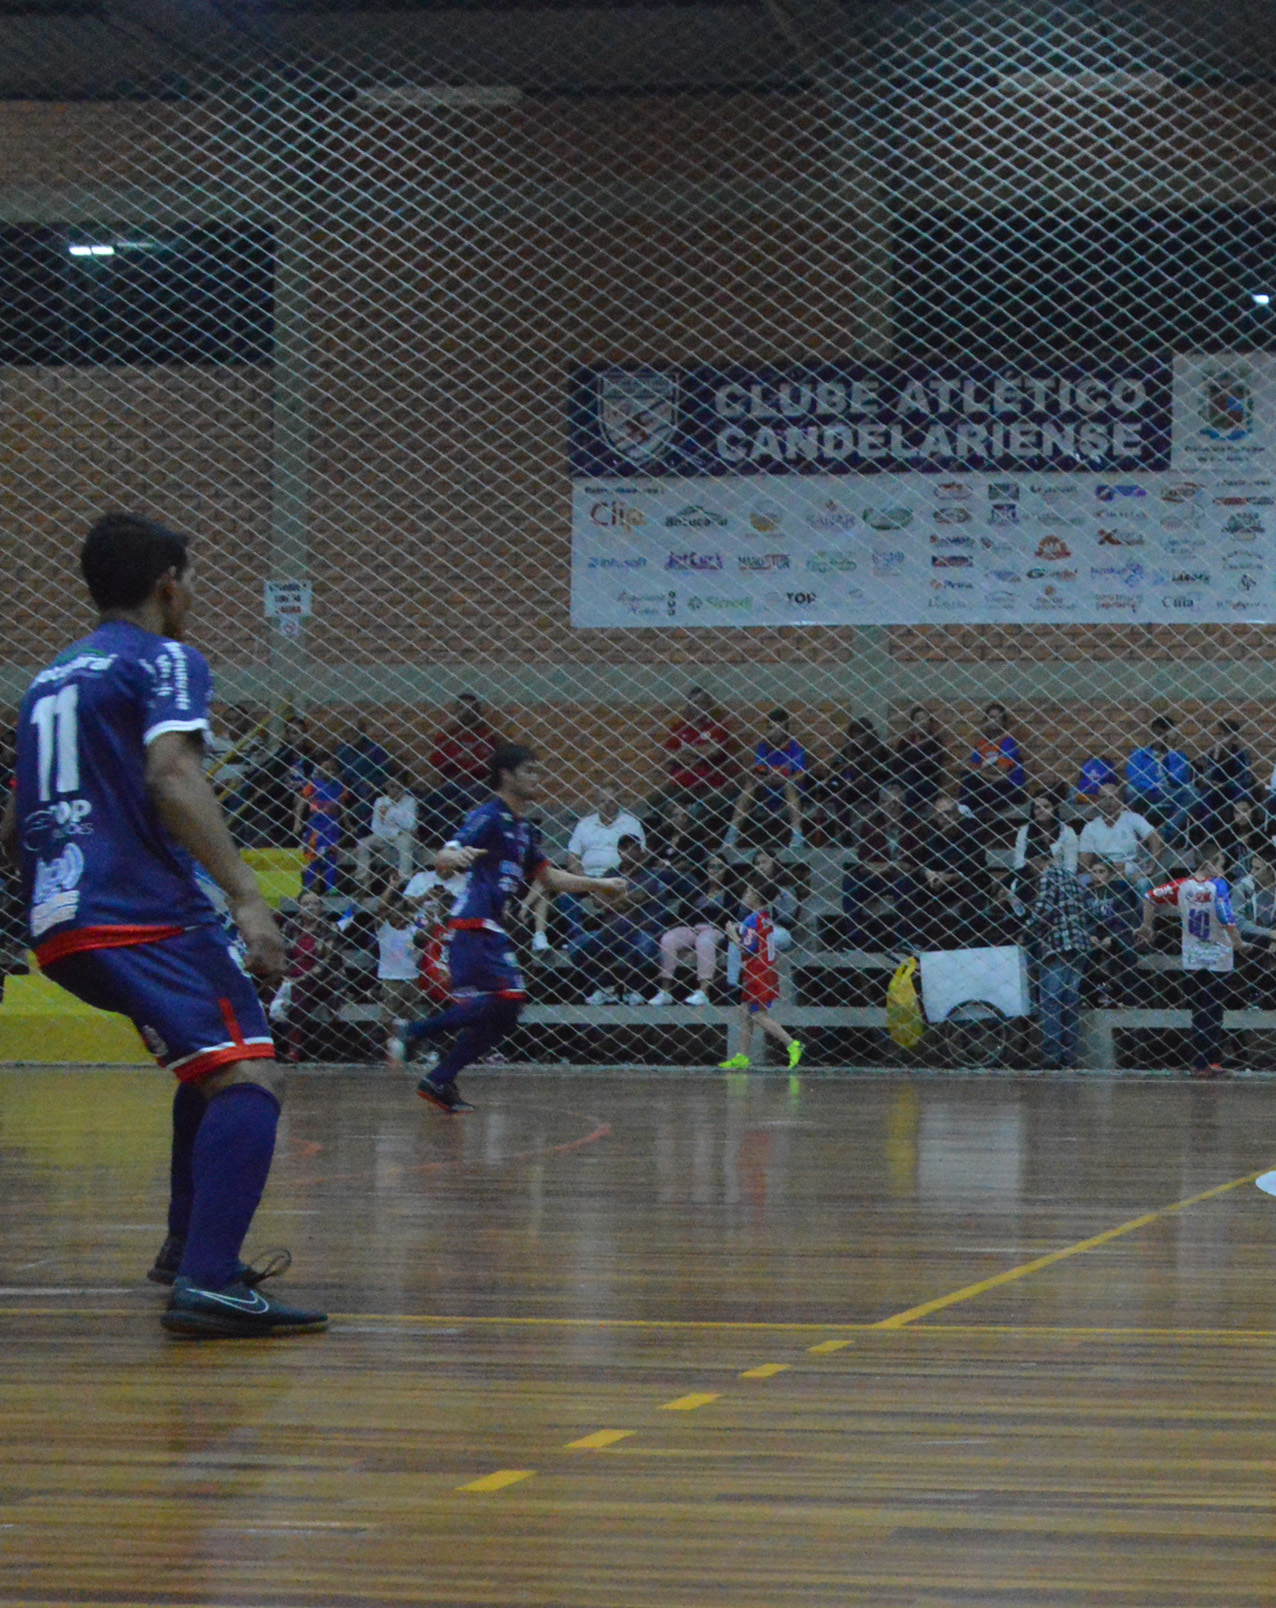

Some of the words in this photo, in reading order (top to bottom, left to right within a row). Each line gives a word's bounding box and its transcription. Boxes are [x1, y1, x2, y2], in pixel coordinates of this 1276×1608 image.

[714, 380, 881, 418] CLUBE
[898, 370, 1147, 415] ATLÉTICO
[714, 421, 1144, 461] CANDELARIENSE
[30, 684, 79, 802] 11
